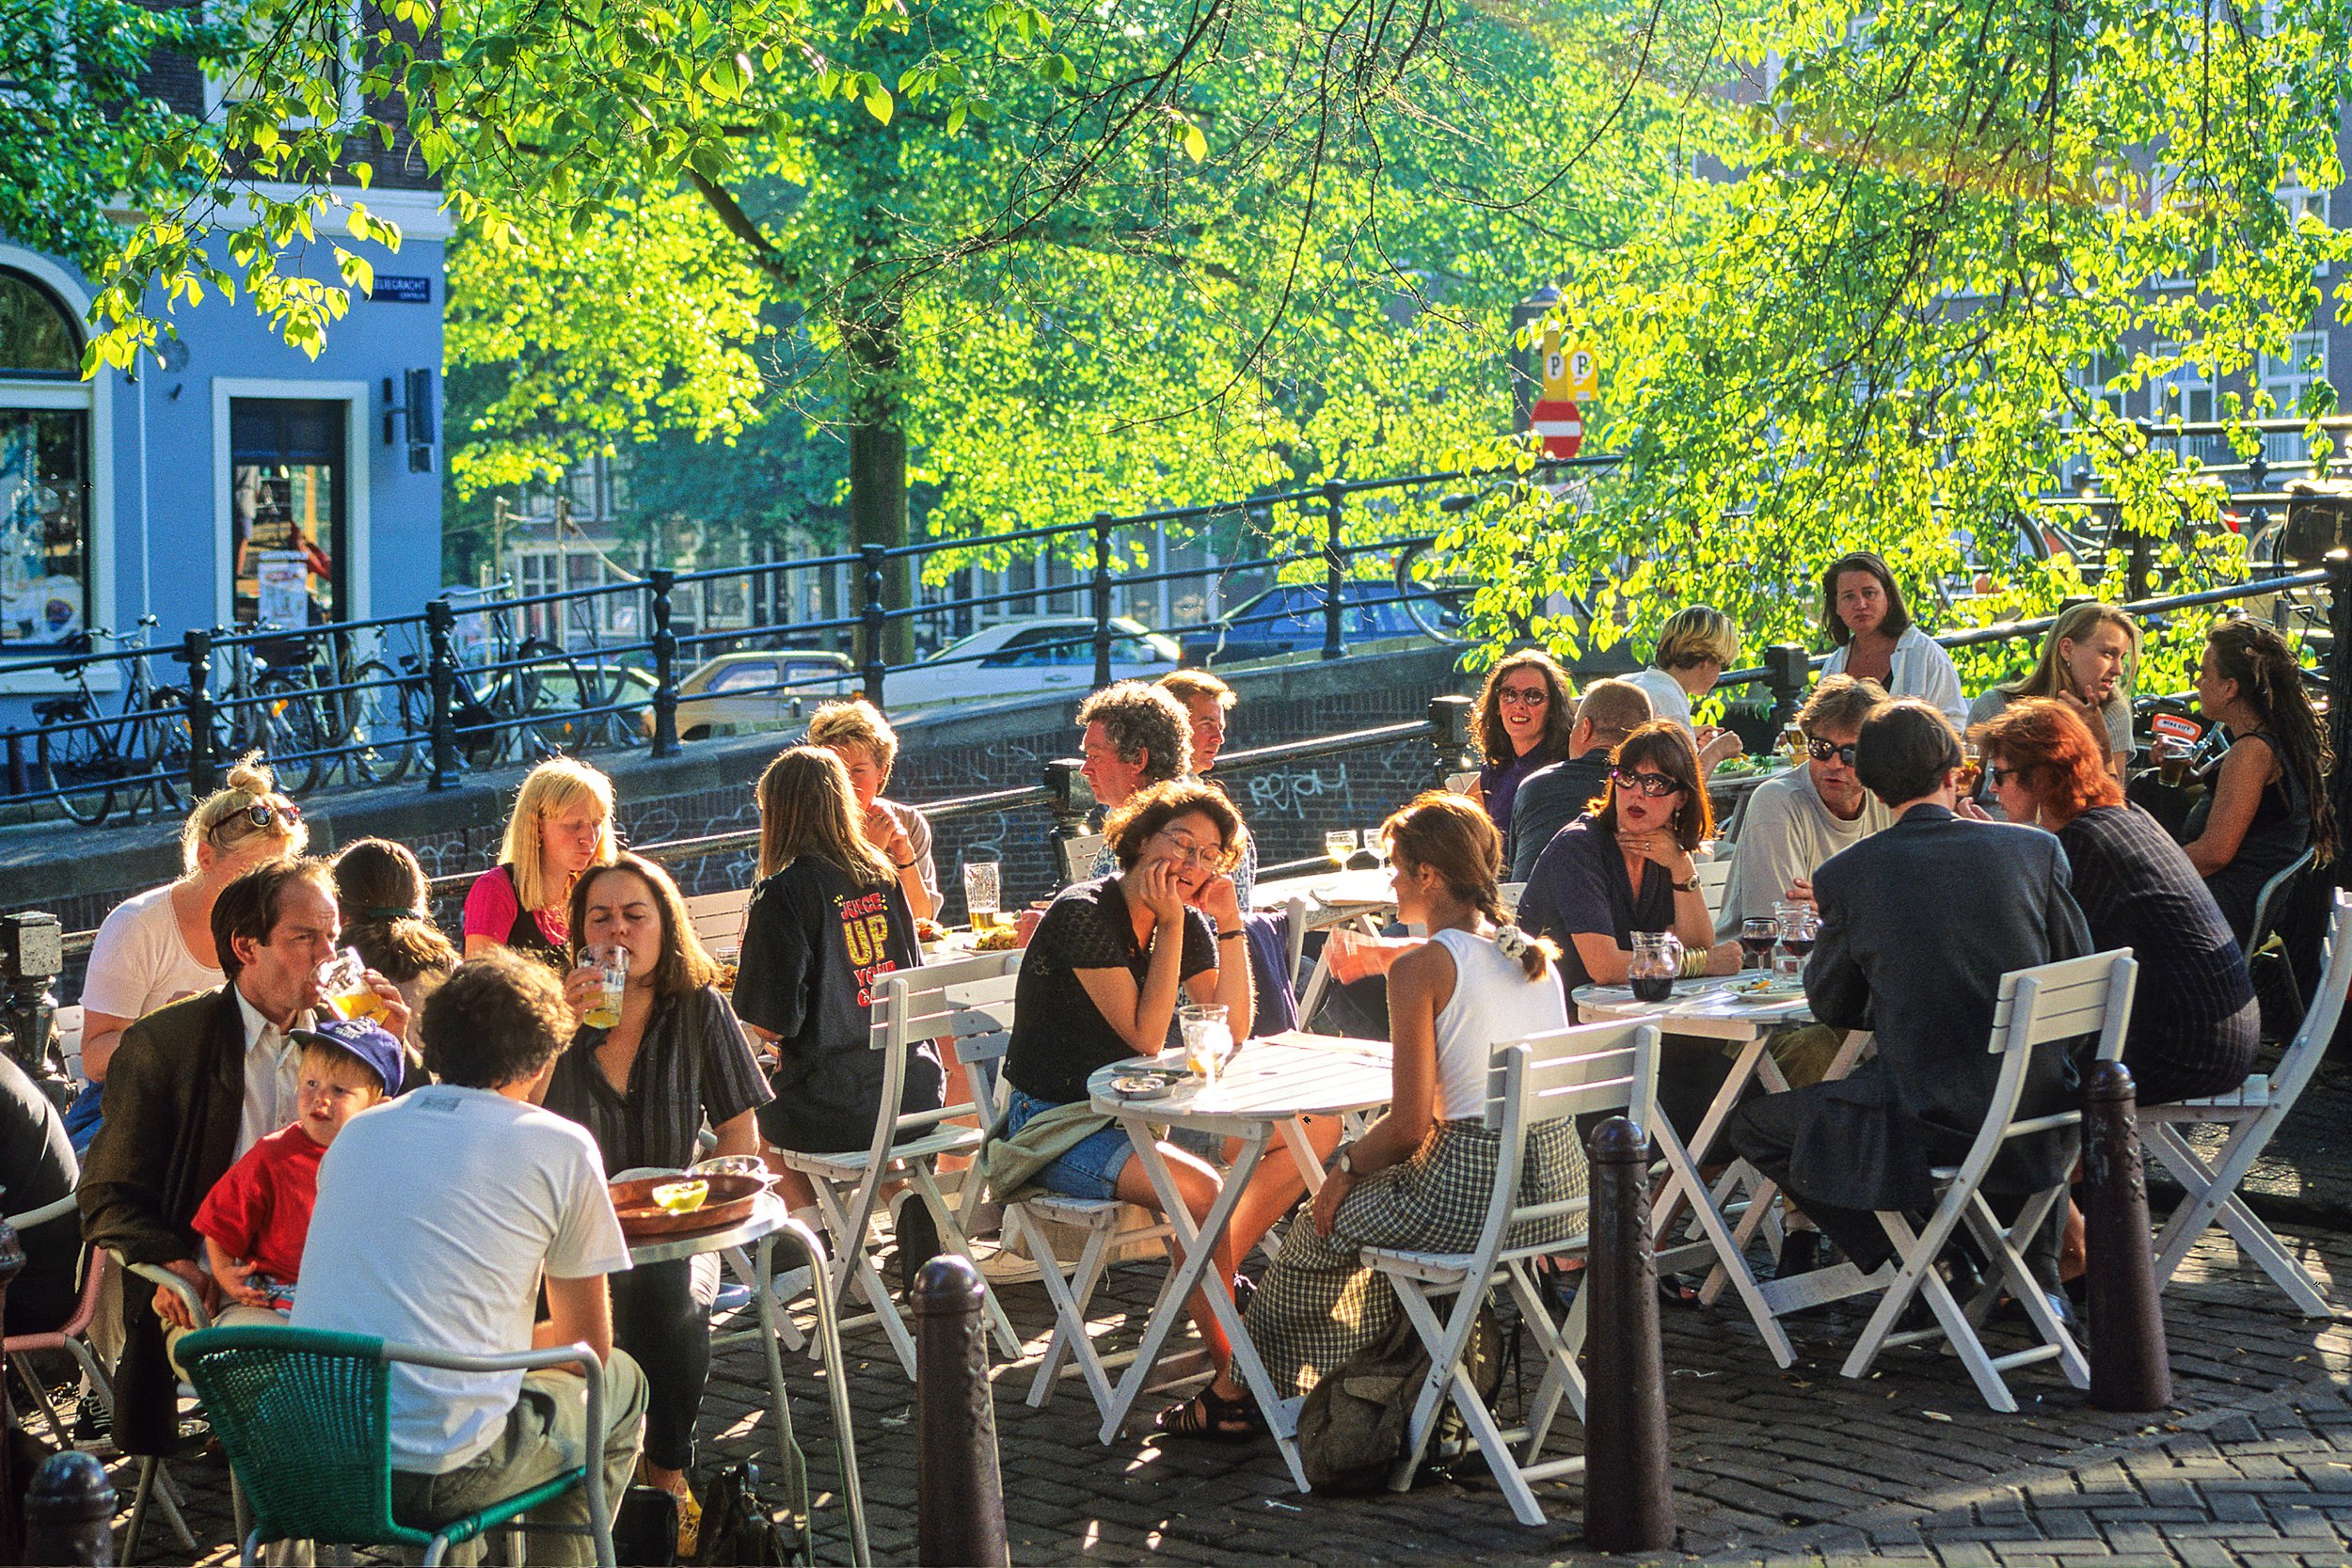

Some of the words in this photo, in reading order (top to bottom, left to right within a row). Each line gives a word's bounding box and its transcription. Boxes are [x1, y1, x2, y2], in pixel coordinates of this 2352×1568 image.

[373, 278, 426, 291] ELIEGRACHT
[1550, 356, 1560, 376] P
[1577, 355, 1588, 375] P
[841, 892, 883, 920] JUICE
[843, 914, 888, 966] UP
